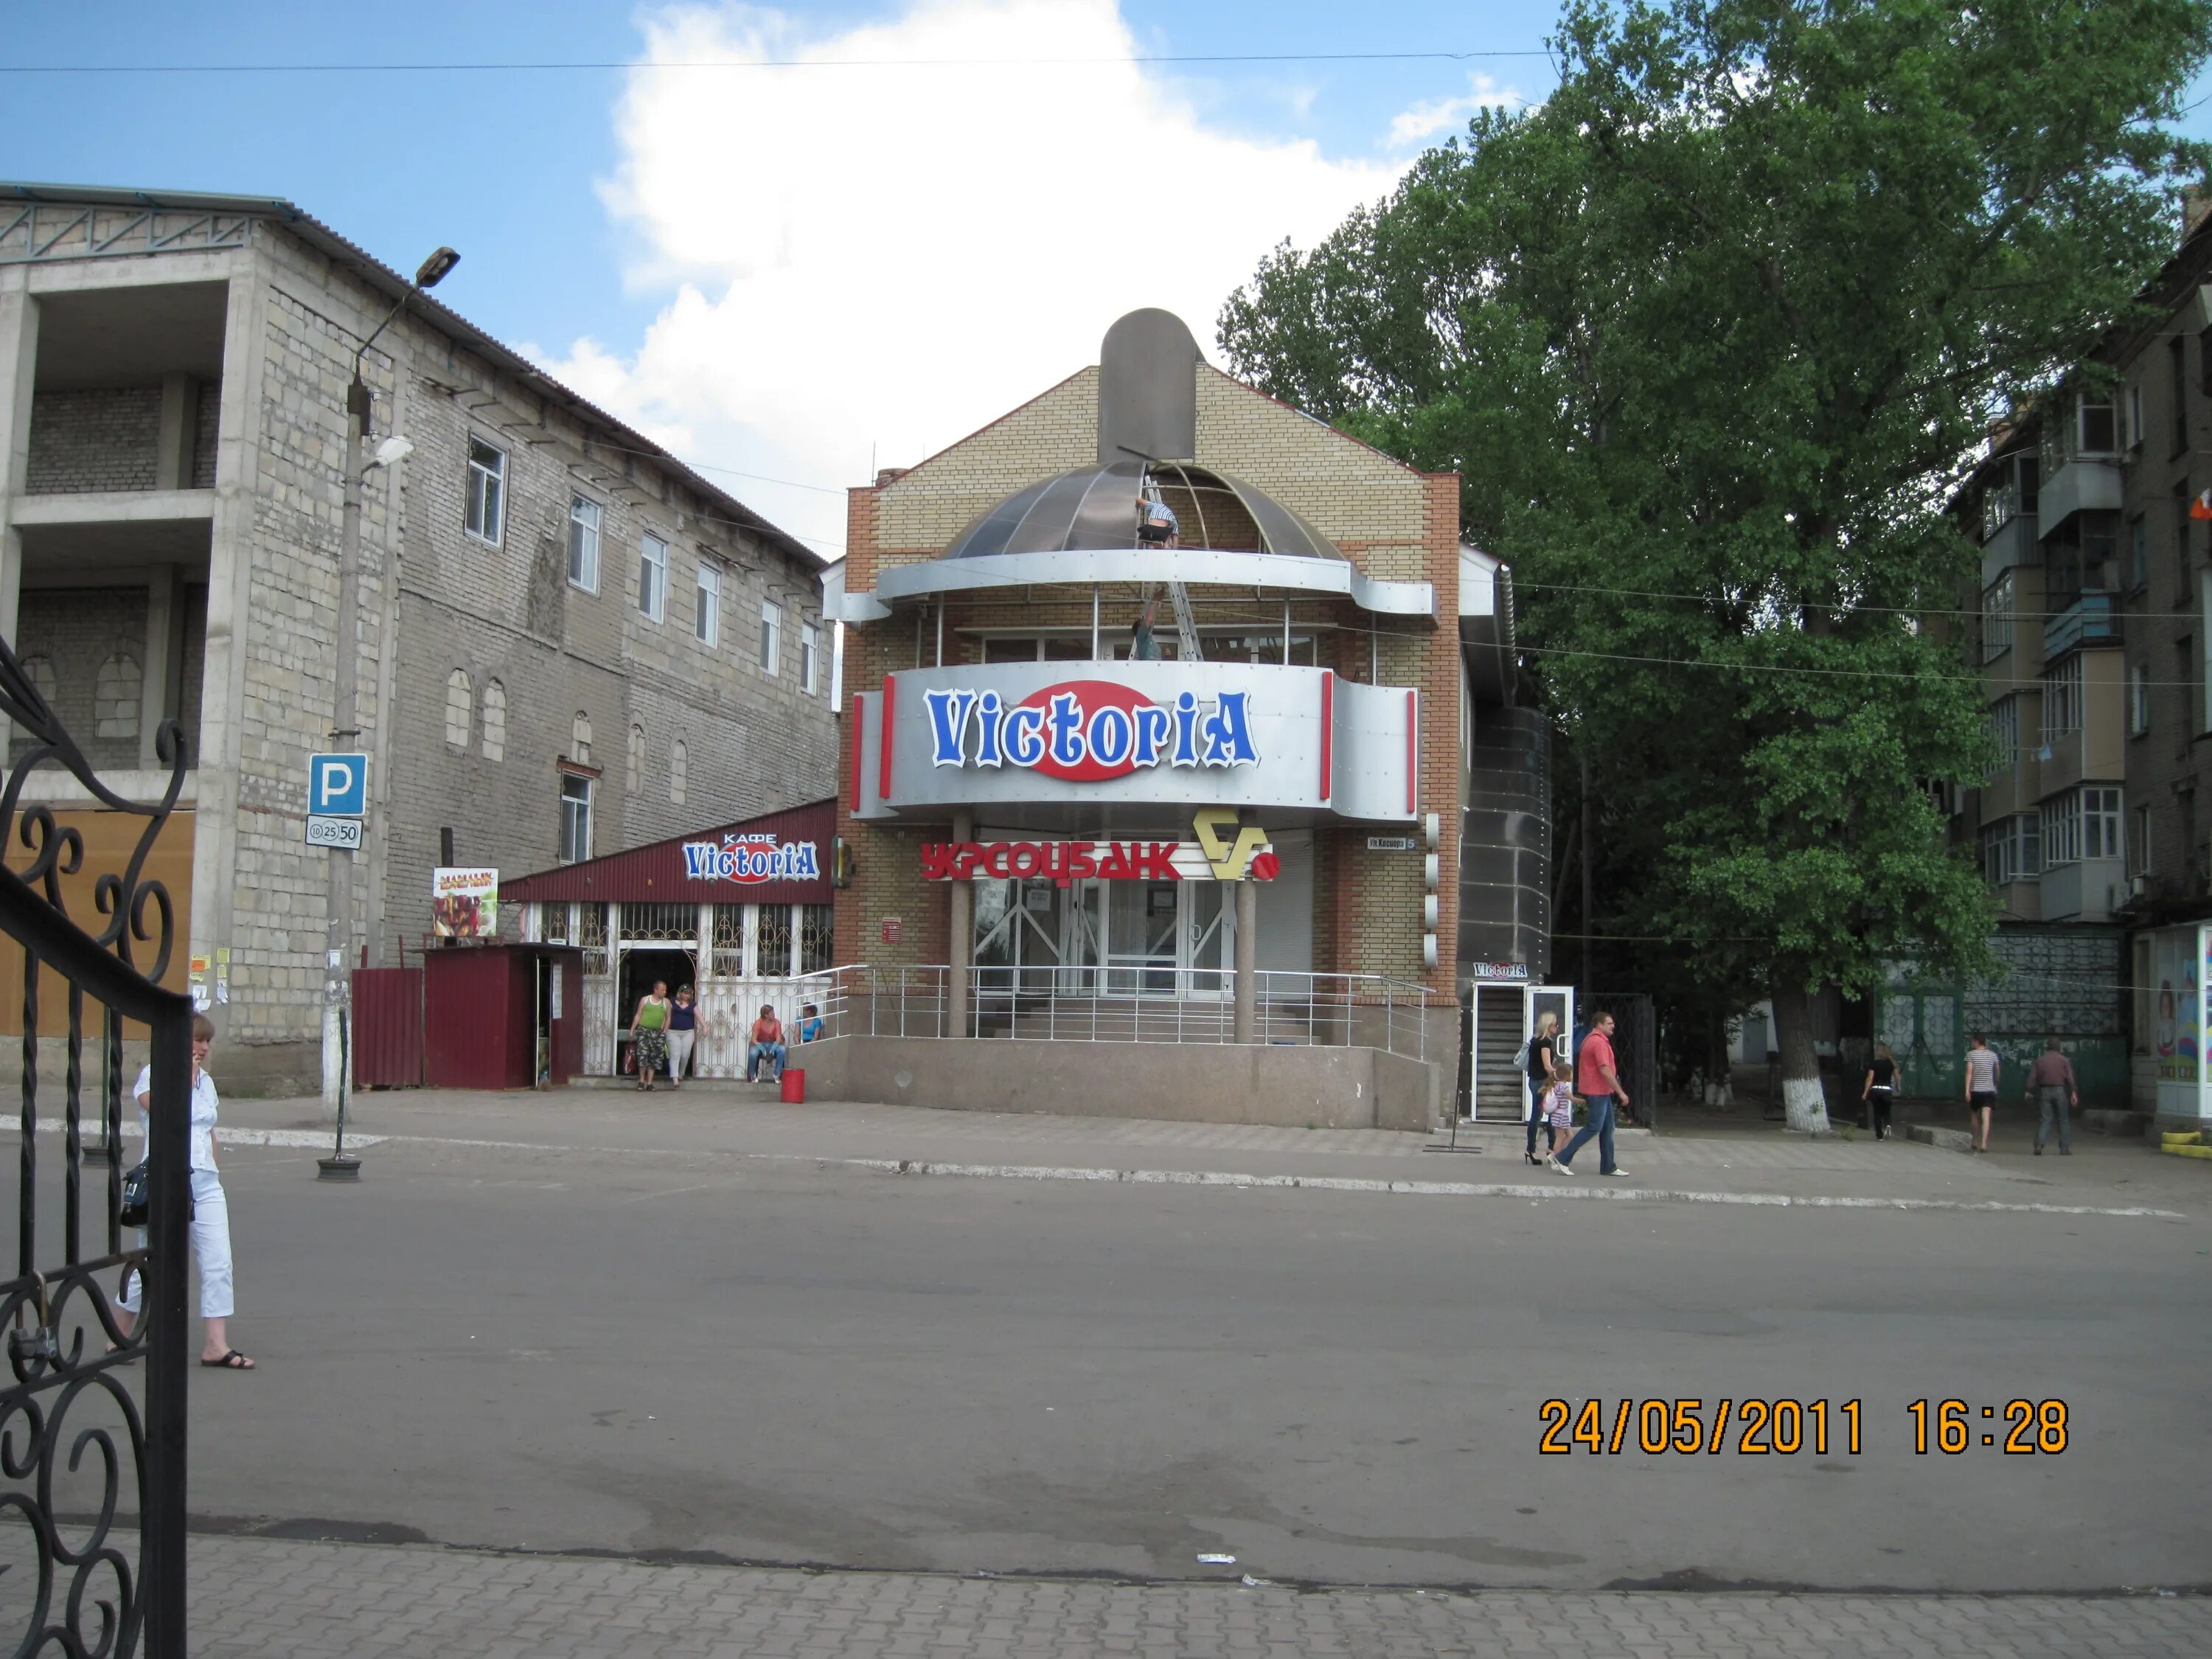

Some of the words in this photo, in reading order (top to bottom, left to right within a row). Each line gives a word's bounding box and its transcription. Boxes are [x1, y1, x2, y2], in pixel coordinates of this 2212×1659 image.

[321, 762, 352, 806] P
[324, 827, 336, 837] 25
[340, 826, 356, 841] 50
[724, 834, 776, 844] КАФЕ
[1407, 839, 1415, 849] 5
[921, 841, 1184, 888] УКРСОЦБАНК
[440, 872, 492, 890] ШАШЛЫК
